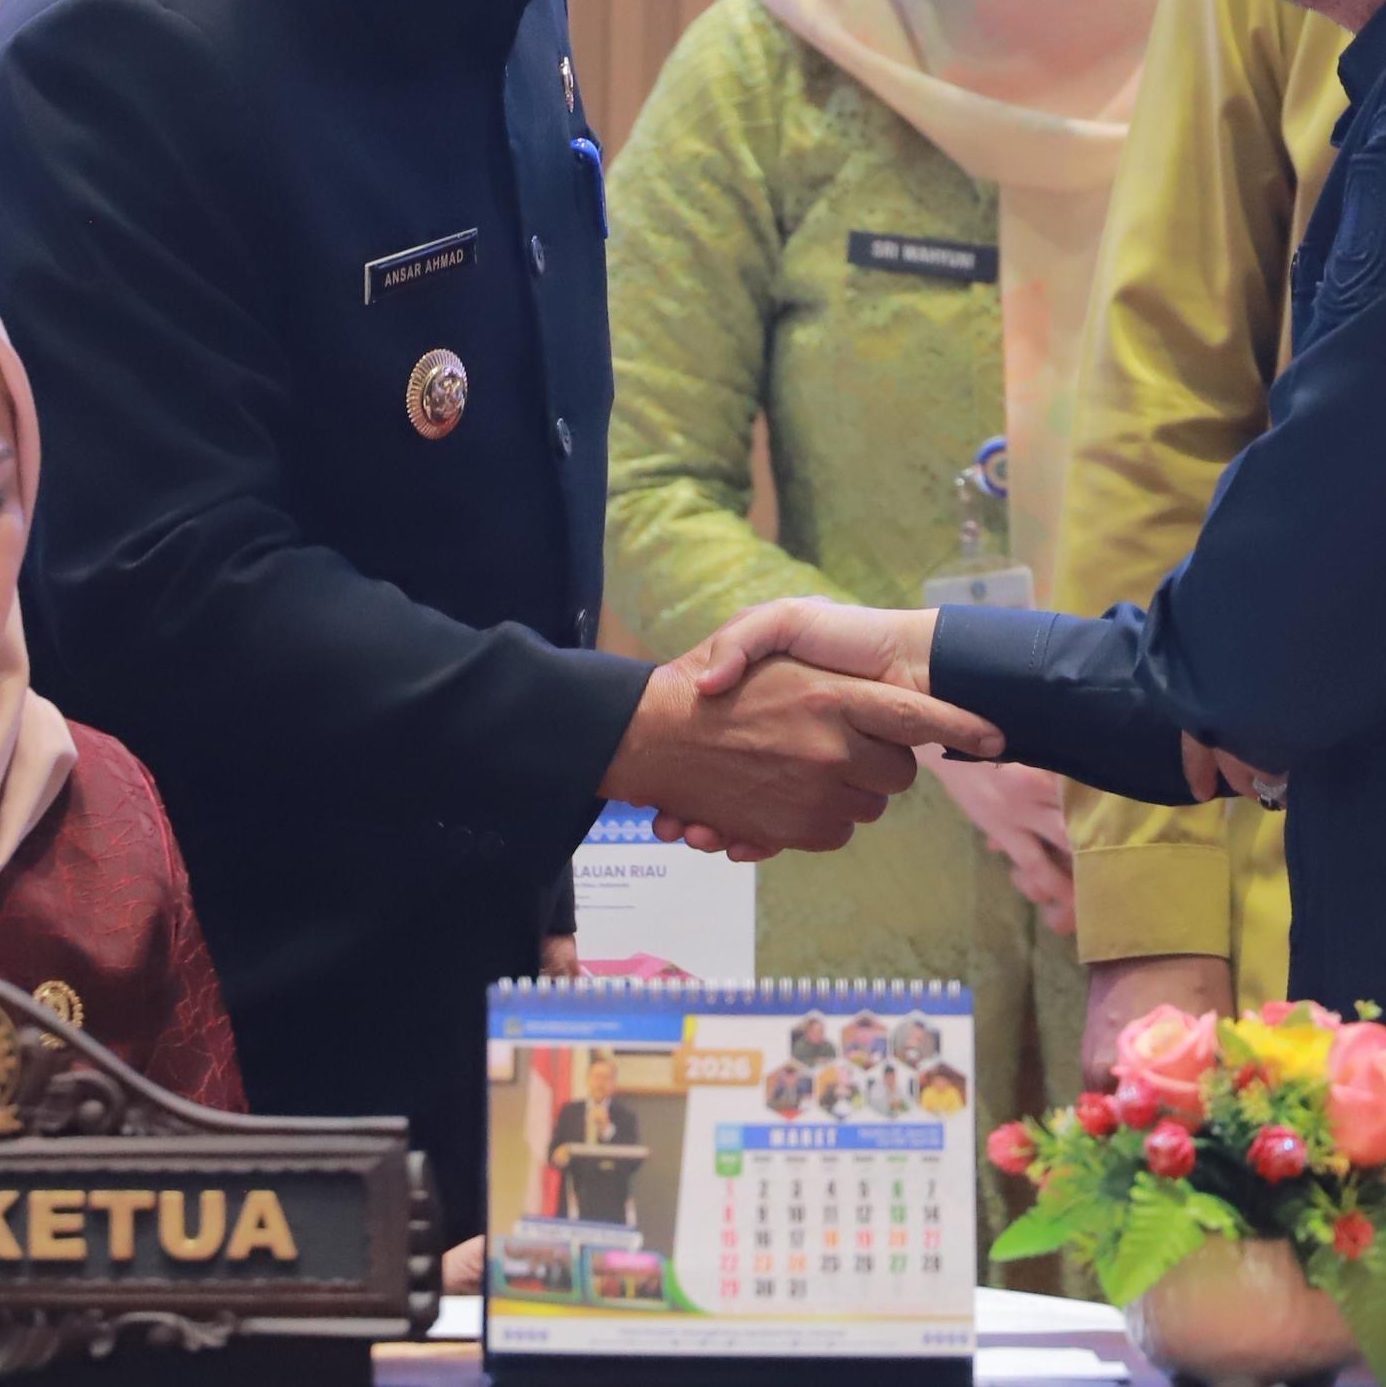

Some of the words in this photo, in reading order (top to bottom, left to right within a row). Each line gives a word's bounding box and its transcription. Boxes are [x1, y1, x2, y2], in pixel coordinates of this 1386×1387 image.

[385, 263, 421, 287] ANSAR
[425, 249, 463, 273] AHMAD
[630, 865, 667, 878] RIAU
[686, 1056, 750, 1080] 2026
